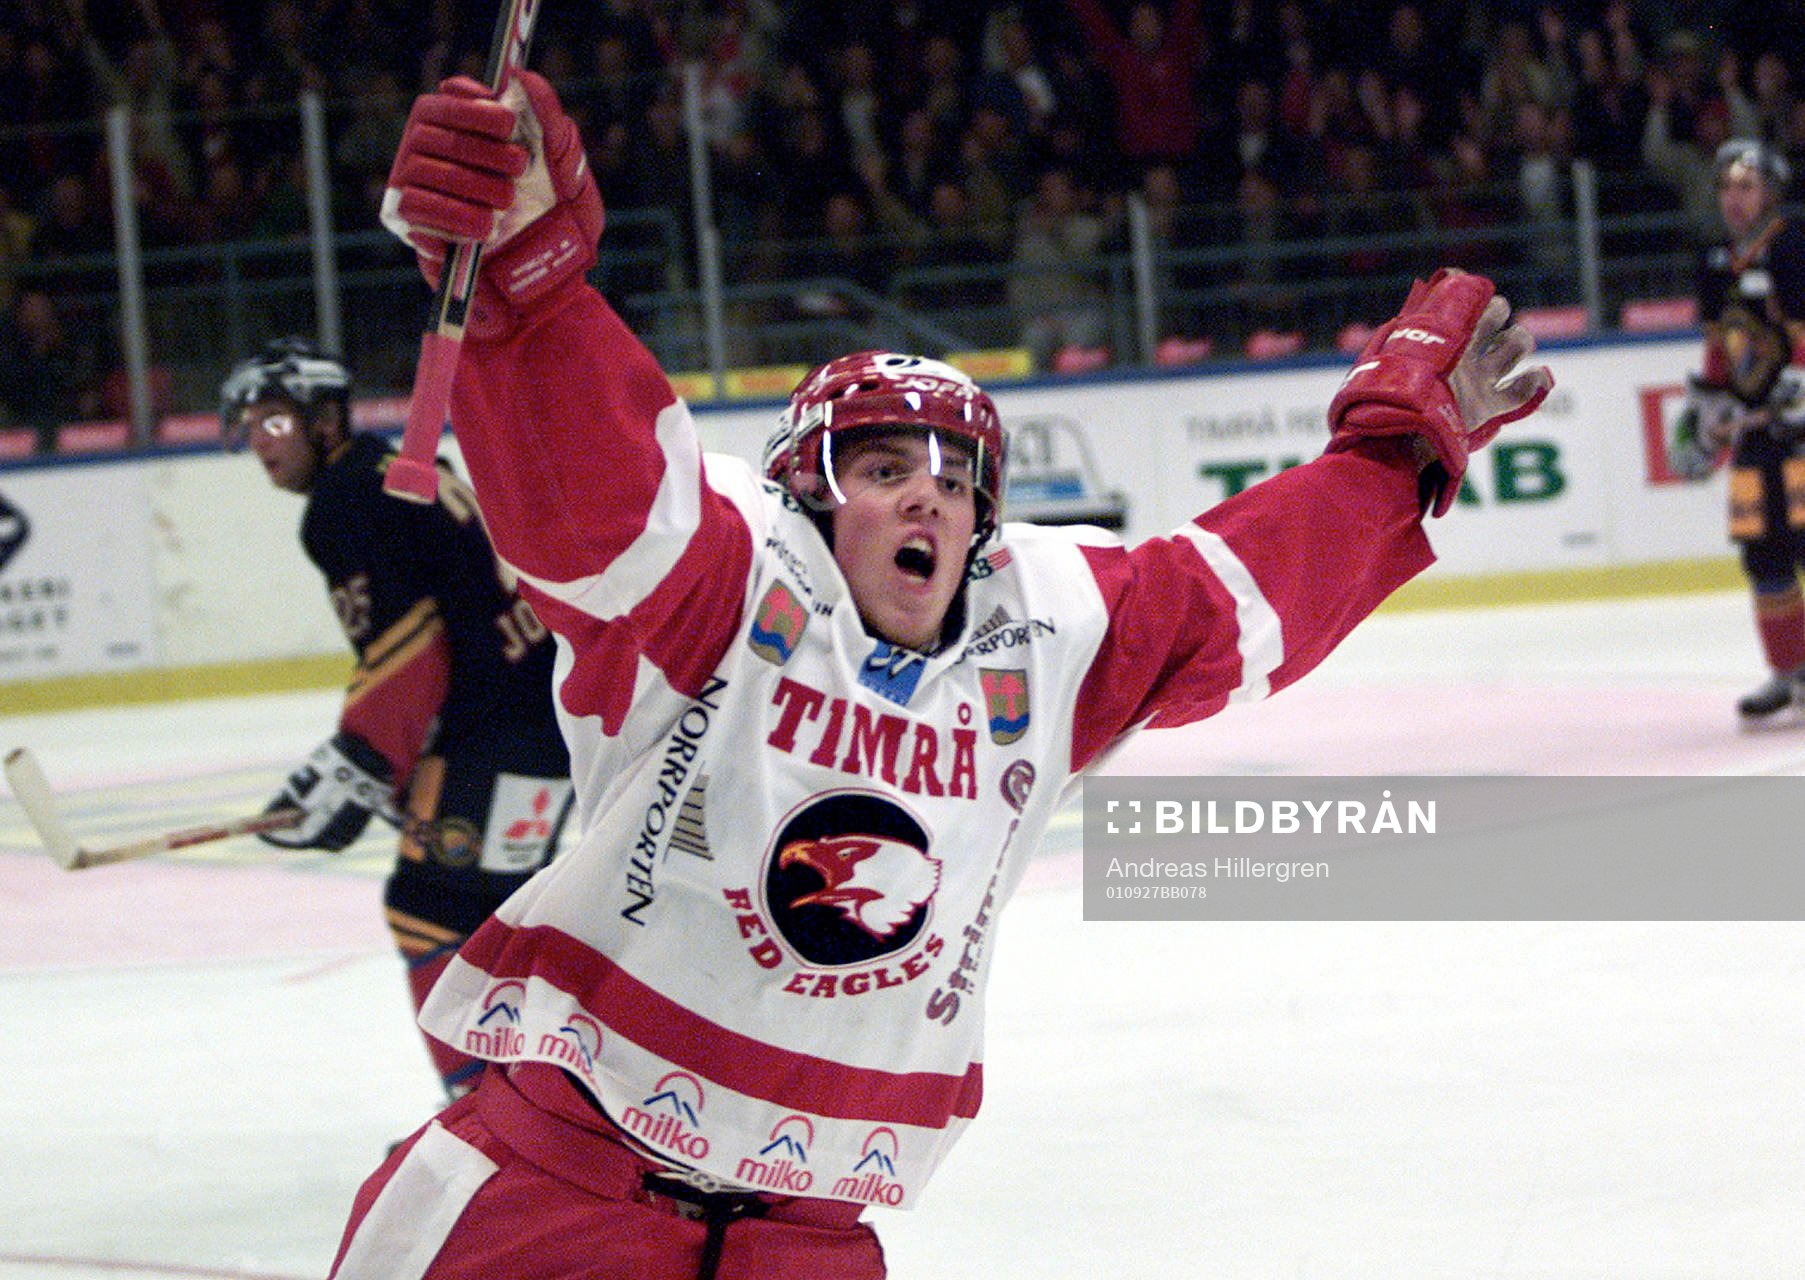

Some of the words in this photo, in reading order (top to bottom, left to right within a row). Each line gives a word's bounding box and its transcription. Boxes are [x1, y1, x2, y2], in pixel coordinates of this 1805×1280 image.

[767, 676, 979, 800] TIMRÅ
[621, 676, 729, 928] NORRPORTEN
[722, 887, 784, 970] RED
[782, 933, 945, 999] EAGLES
[621, 1104, 710, 1159] milko
[735, 1154, 813, 1192] milko
[831, 1173, 904, 1206] milko
